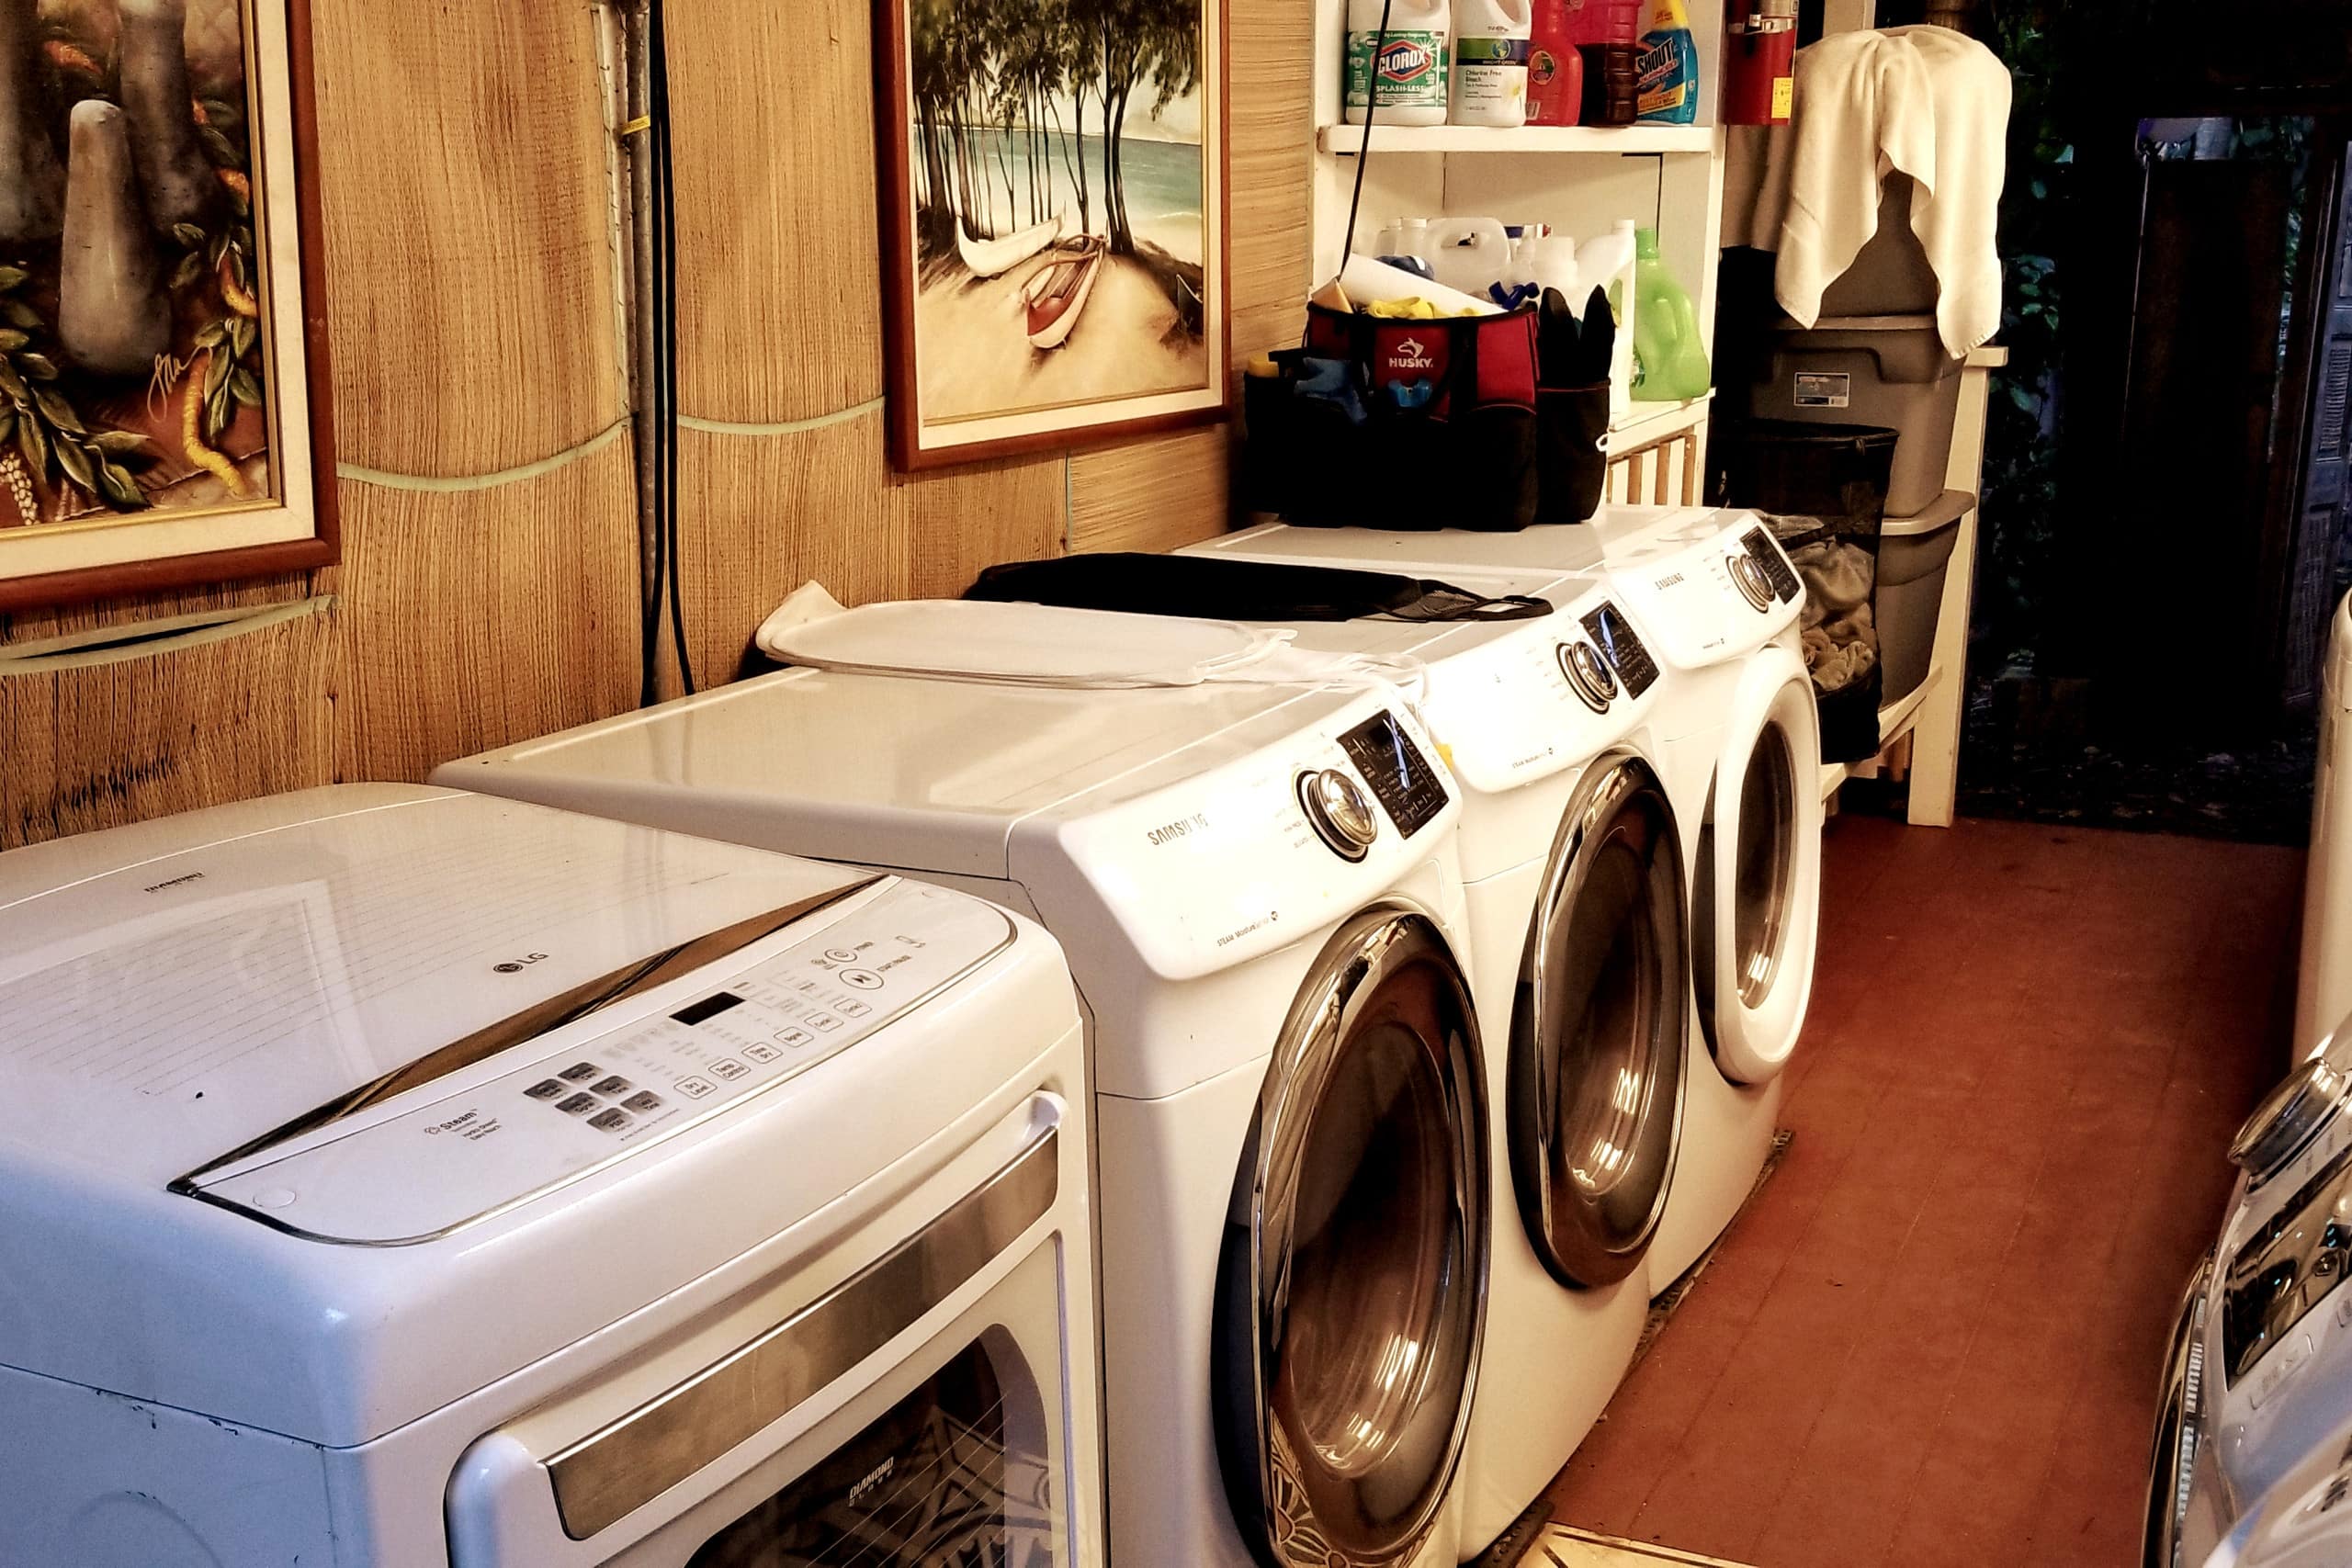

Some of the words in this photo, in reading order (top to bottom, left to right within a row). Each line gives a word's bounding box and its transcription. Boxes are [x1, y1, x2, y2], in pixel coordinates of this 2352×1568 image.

[1378, 50, 1427, 73] CLOROX
[1389, 358, 1432, 367] HUSKY
[515, 953, 549, 964] LG
[439, 1111, 477, 1130] Steam
[849, 1456, 894, 1499] DIAMOND
